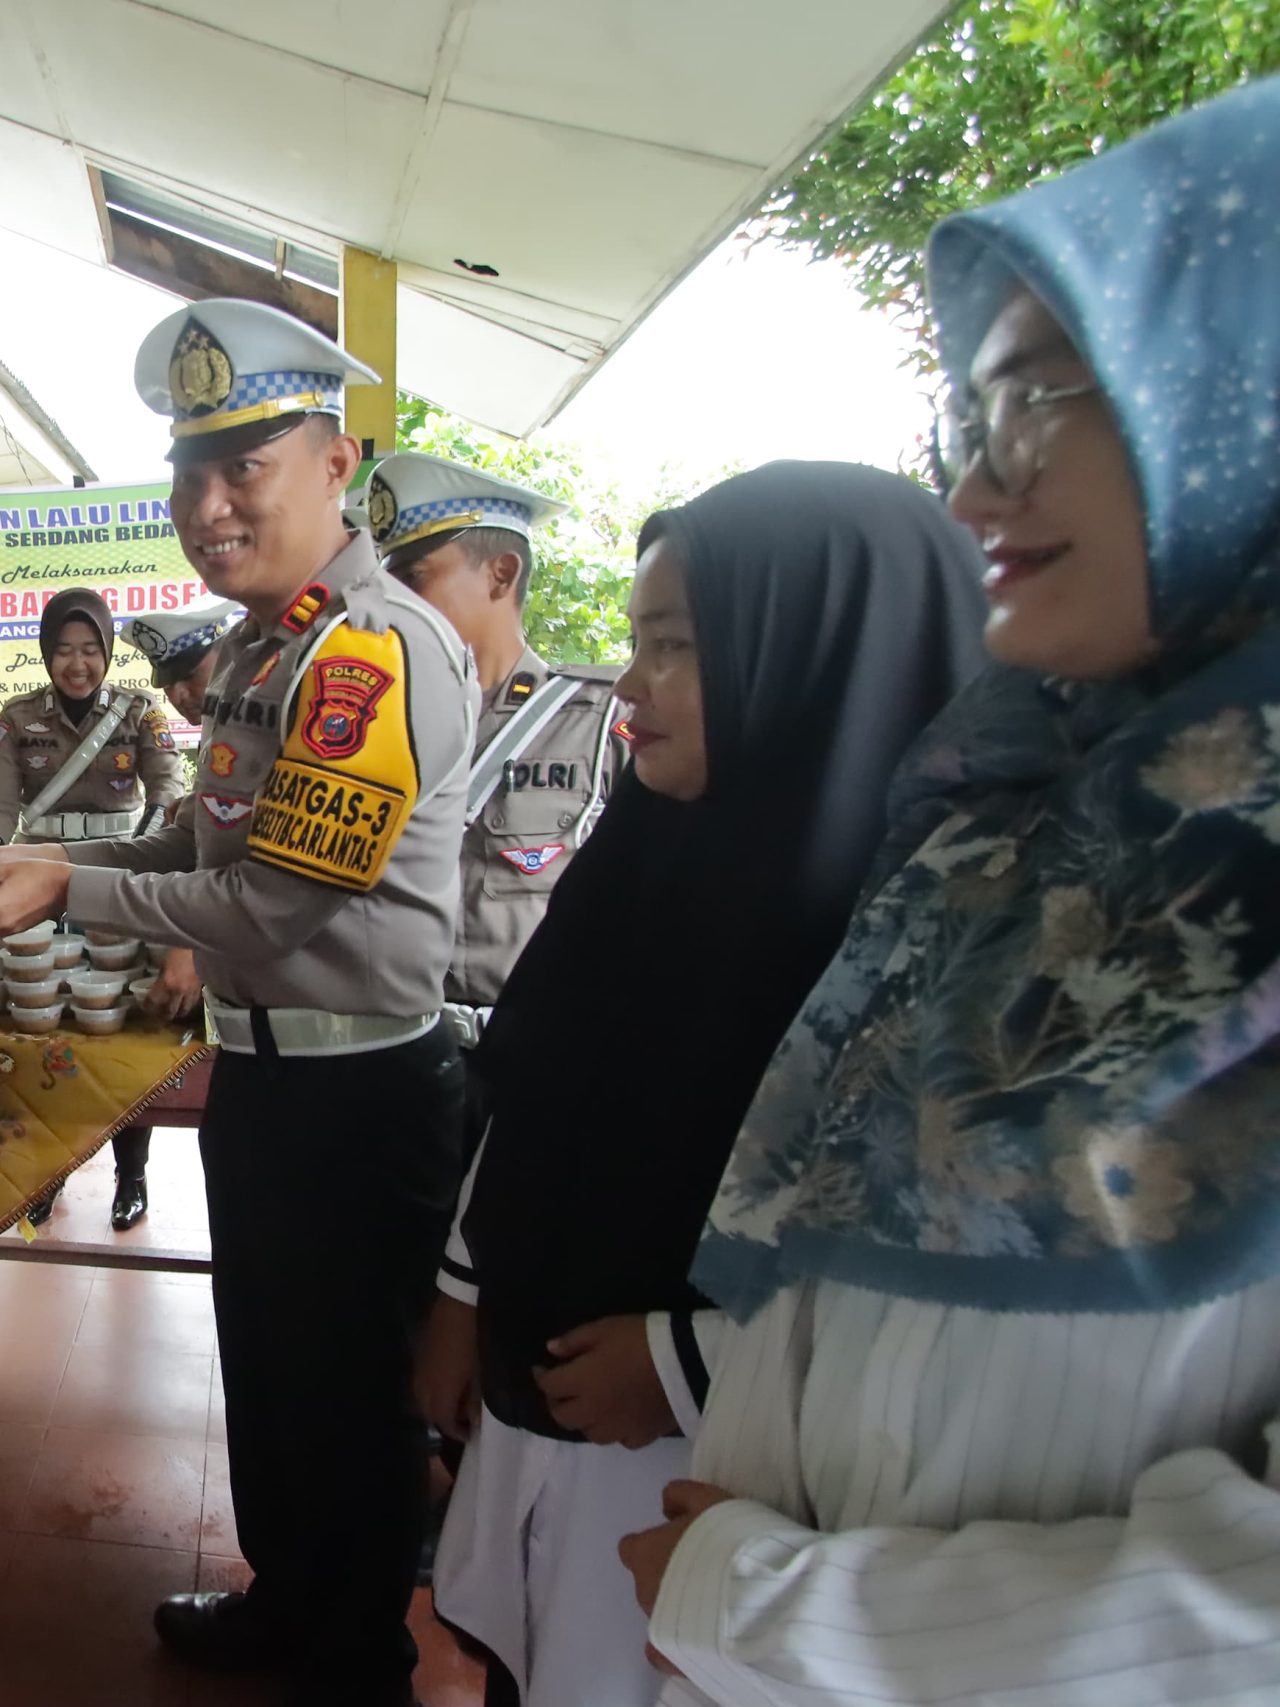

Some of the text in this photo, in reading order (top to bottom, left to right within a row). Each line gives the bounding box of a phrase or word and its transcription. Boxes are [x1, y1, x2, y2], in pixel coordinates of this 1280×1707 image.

[28, 504, 111, 529] LALU
[119, 499, 171, 523] LIN
[5, 528, 110, 547] SERDANG
[116, 523, 176, 541] BEDA
[1, 560, 158, 584] Melaksanakan
[127, 582, 208, 612] DISE
[5, 653, 45, 673] Dal
[13, 680, 51, 693] MEN
[119, 678, 150, 689] PRO
[325, 666, 380, 686] POLRES
[506, 762, 577, 790] OLRI
